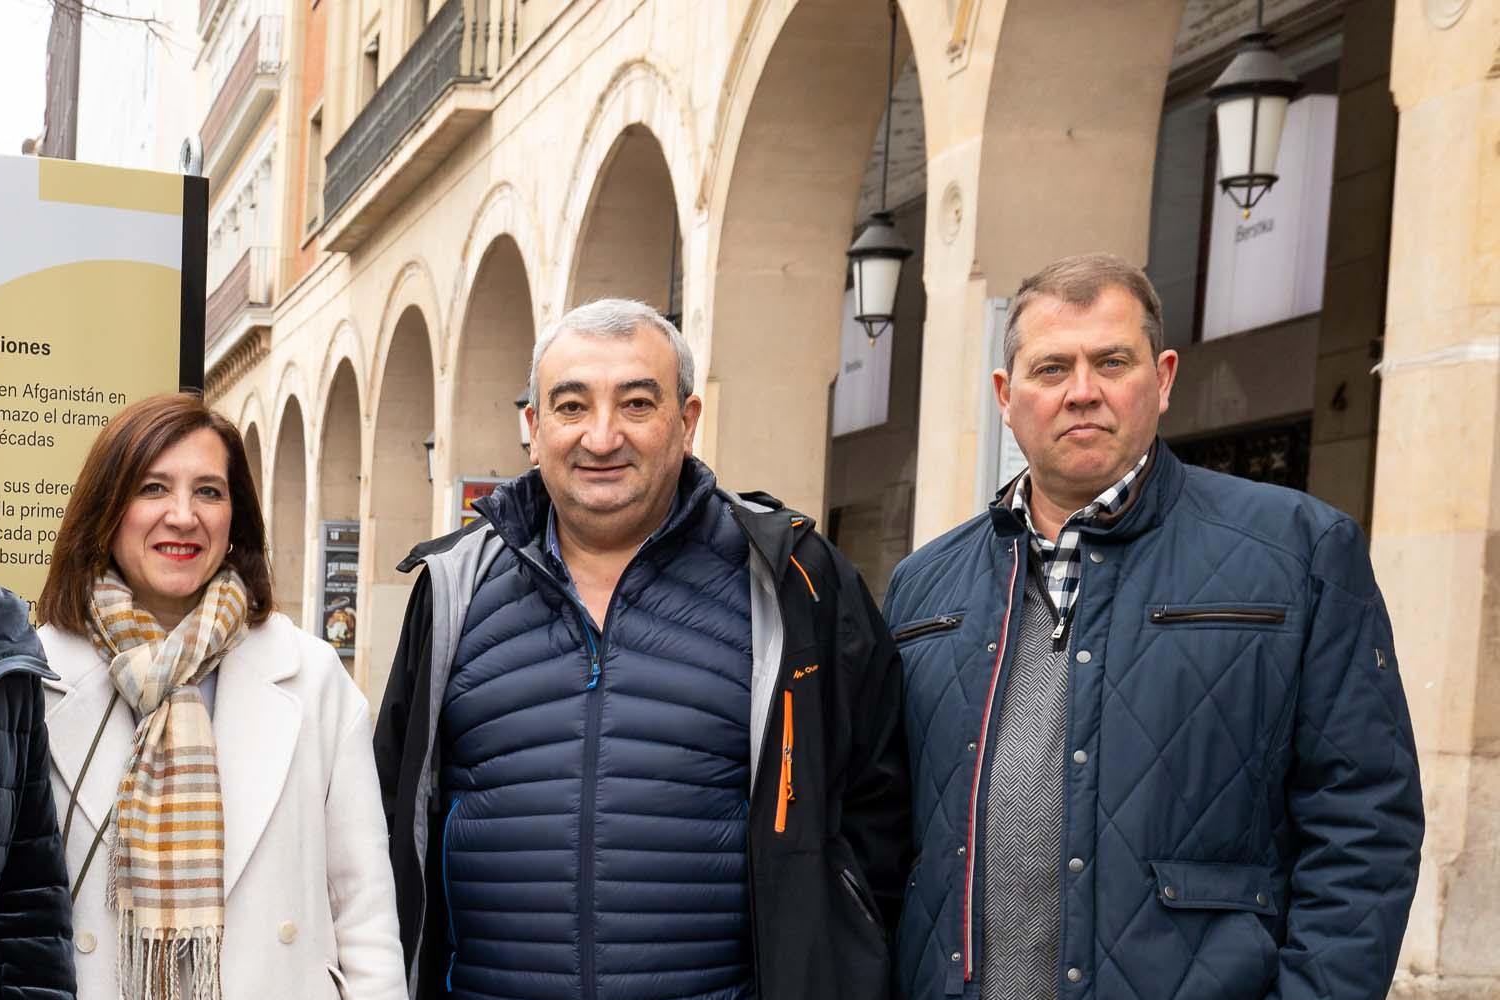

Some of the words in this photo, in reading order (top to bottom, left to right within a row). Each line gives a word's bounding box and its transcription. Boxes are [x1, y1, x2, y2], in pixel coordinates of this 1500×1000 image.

[22, 383, 104, 403] Afganistán
[109, 392, 126, 405] en
[62, 409, 109, 427] drama
[4, 481, 30, 494] sus
